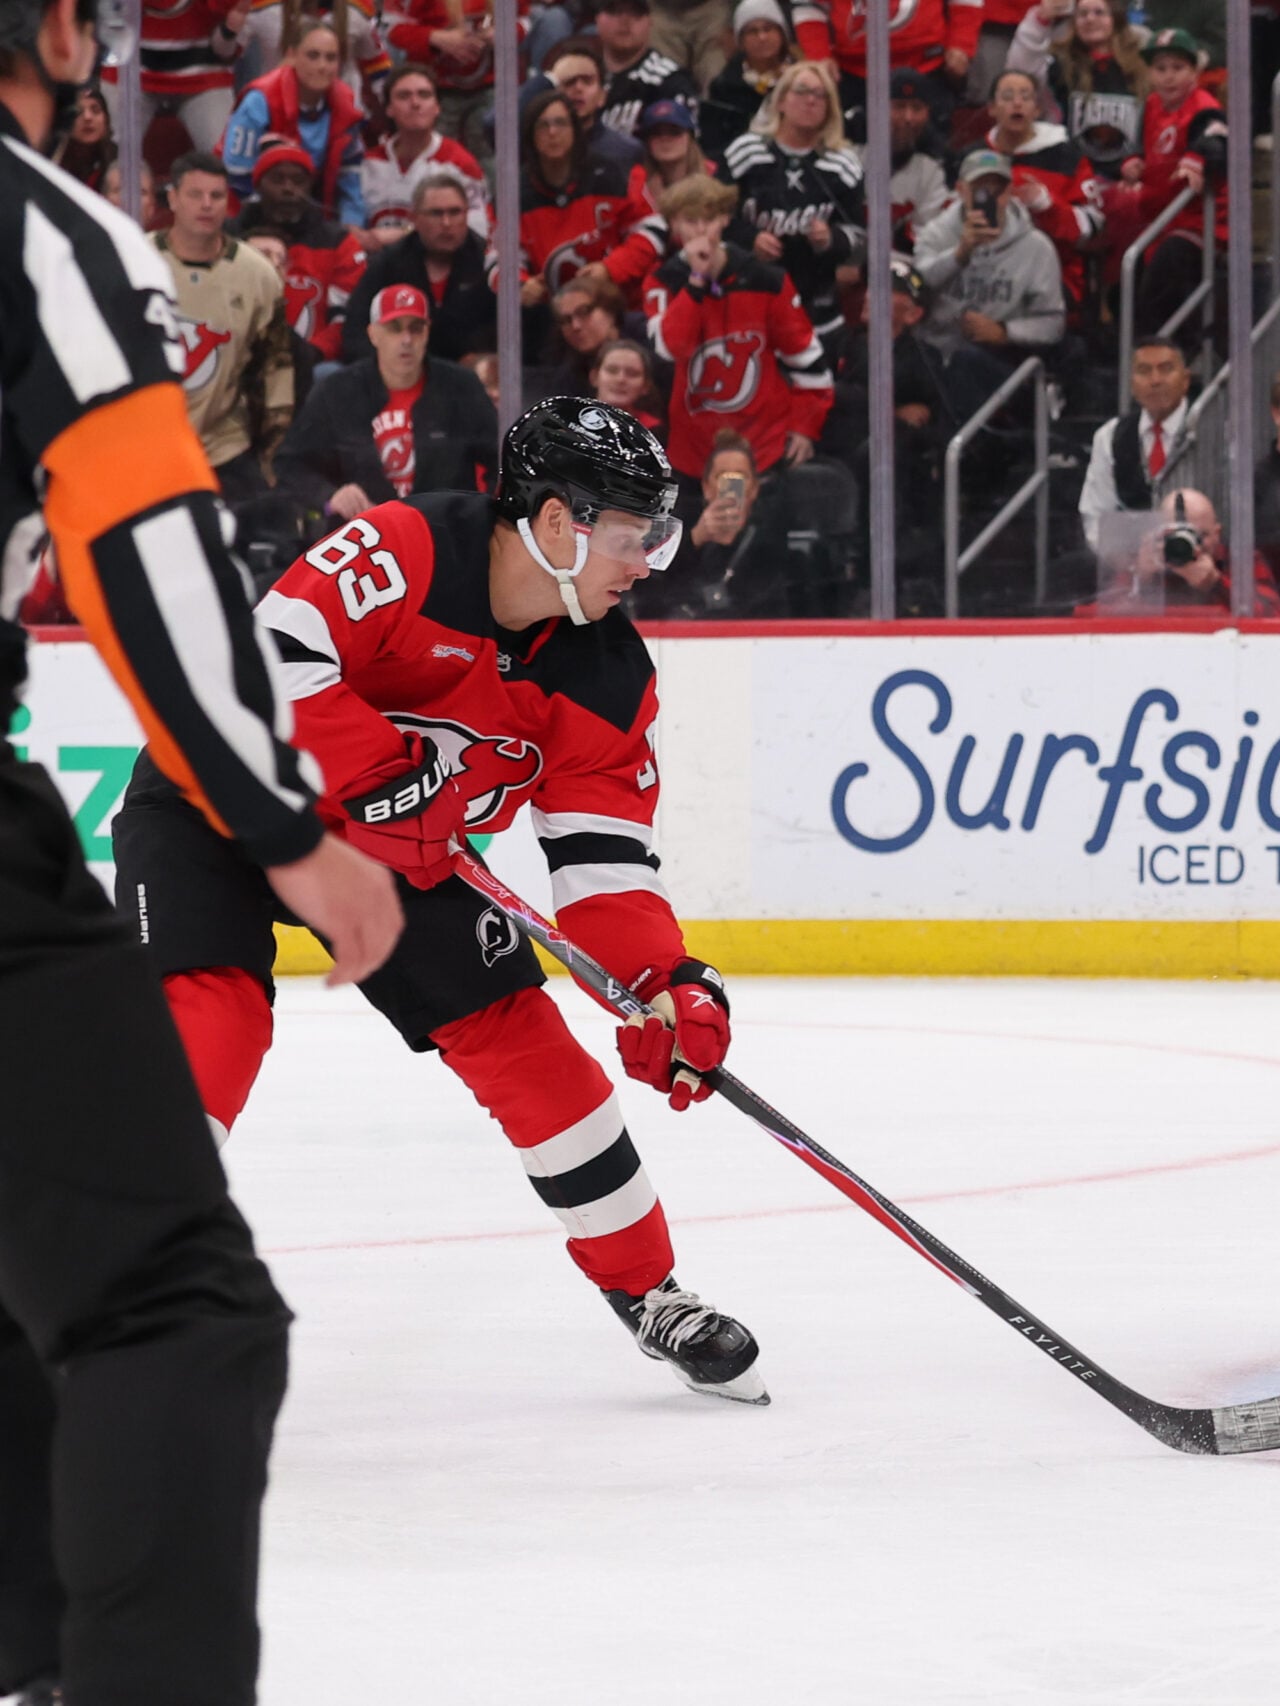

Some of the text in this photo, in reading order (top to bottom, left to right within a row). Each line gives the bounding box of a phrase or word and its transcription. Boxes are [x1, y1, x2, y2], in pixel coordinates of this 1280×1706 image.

[305, 518, 408, 622] 63
[1139, 845, 1245, 886] ICED
[1008, 1315, 1097, 1380] FLYLITE
